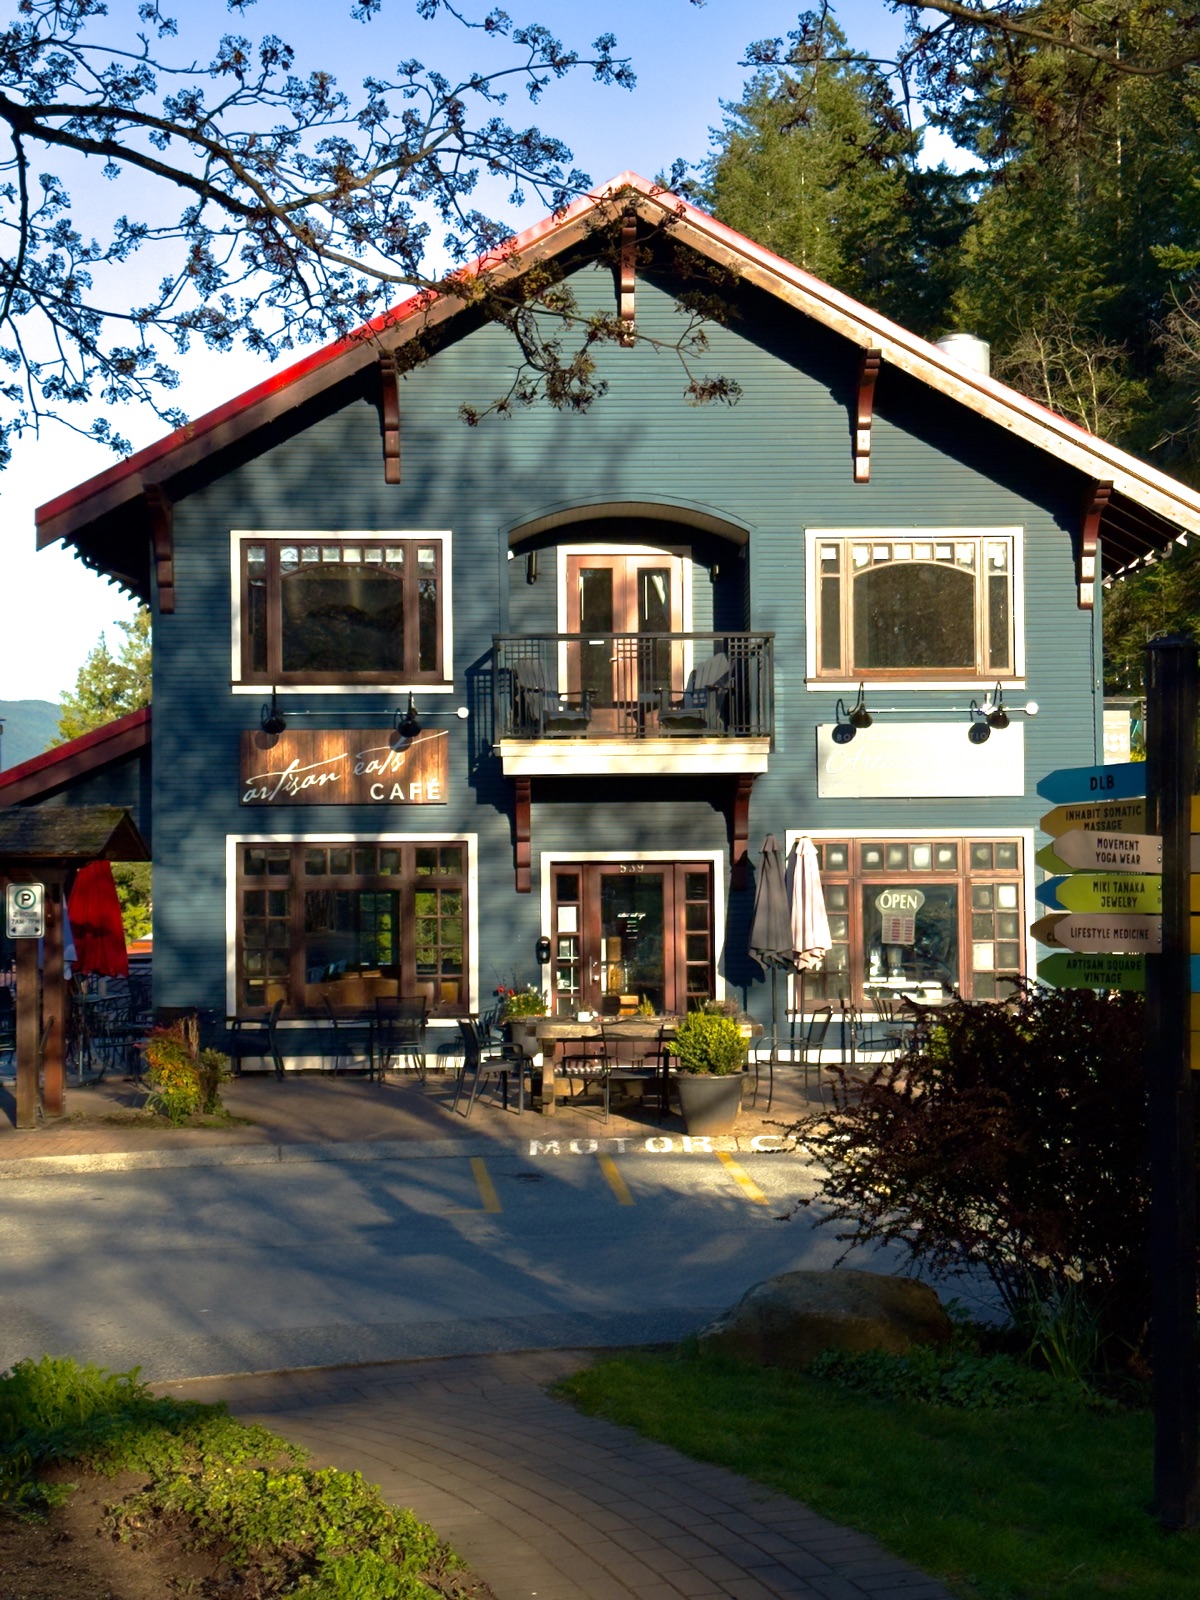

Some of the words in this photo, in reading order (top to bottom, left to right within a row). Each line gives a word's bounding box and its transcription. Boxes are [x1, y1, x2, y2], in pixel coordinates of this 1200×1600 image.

[242, 753, 348, 803] artisan
[1090, 774, 1115, 791] DLB
[1065, 808, 1100, 822] INHABIT
[1103, 805, 1142, 818] SOMATIC
[1084, 819, 1122, 832] MASSAGE
[1096, 838, 1139, 851] MOVEMENT
[1095, 852, 1117, 864] YOGA
[1119, 852, 1141, 865] WEAR
[1093, 881, 1110, 894] MIKI
[1113, 882, 1145, 894] TANAKA
[21, 893, 31, 905] P
[879, 892, 918, 910] OPEN
[1101, 896, 1138, 909] JEWELRY
[1070, 927, 1111, 940] LIFESTYLE
[1113, 928, 1150, 941] MEDICINE
[1066, 958, 1103, 971] ARTISAN
[1107, 959, 1142, 971] SQUARE
[1084, 971, 1122, 984] VINTAGE
[528, 1136, 714, 1155] MOTOR
